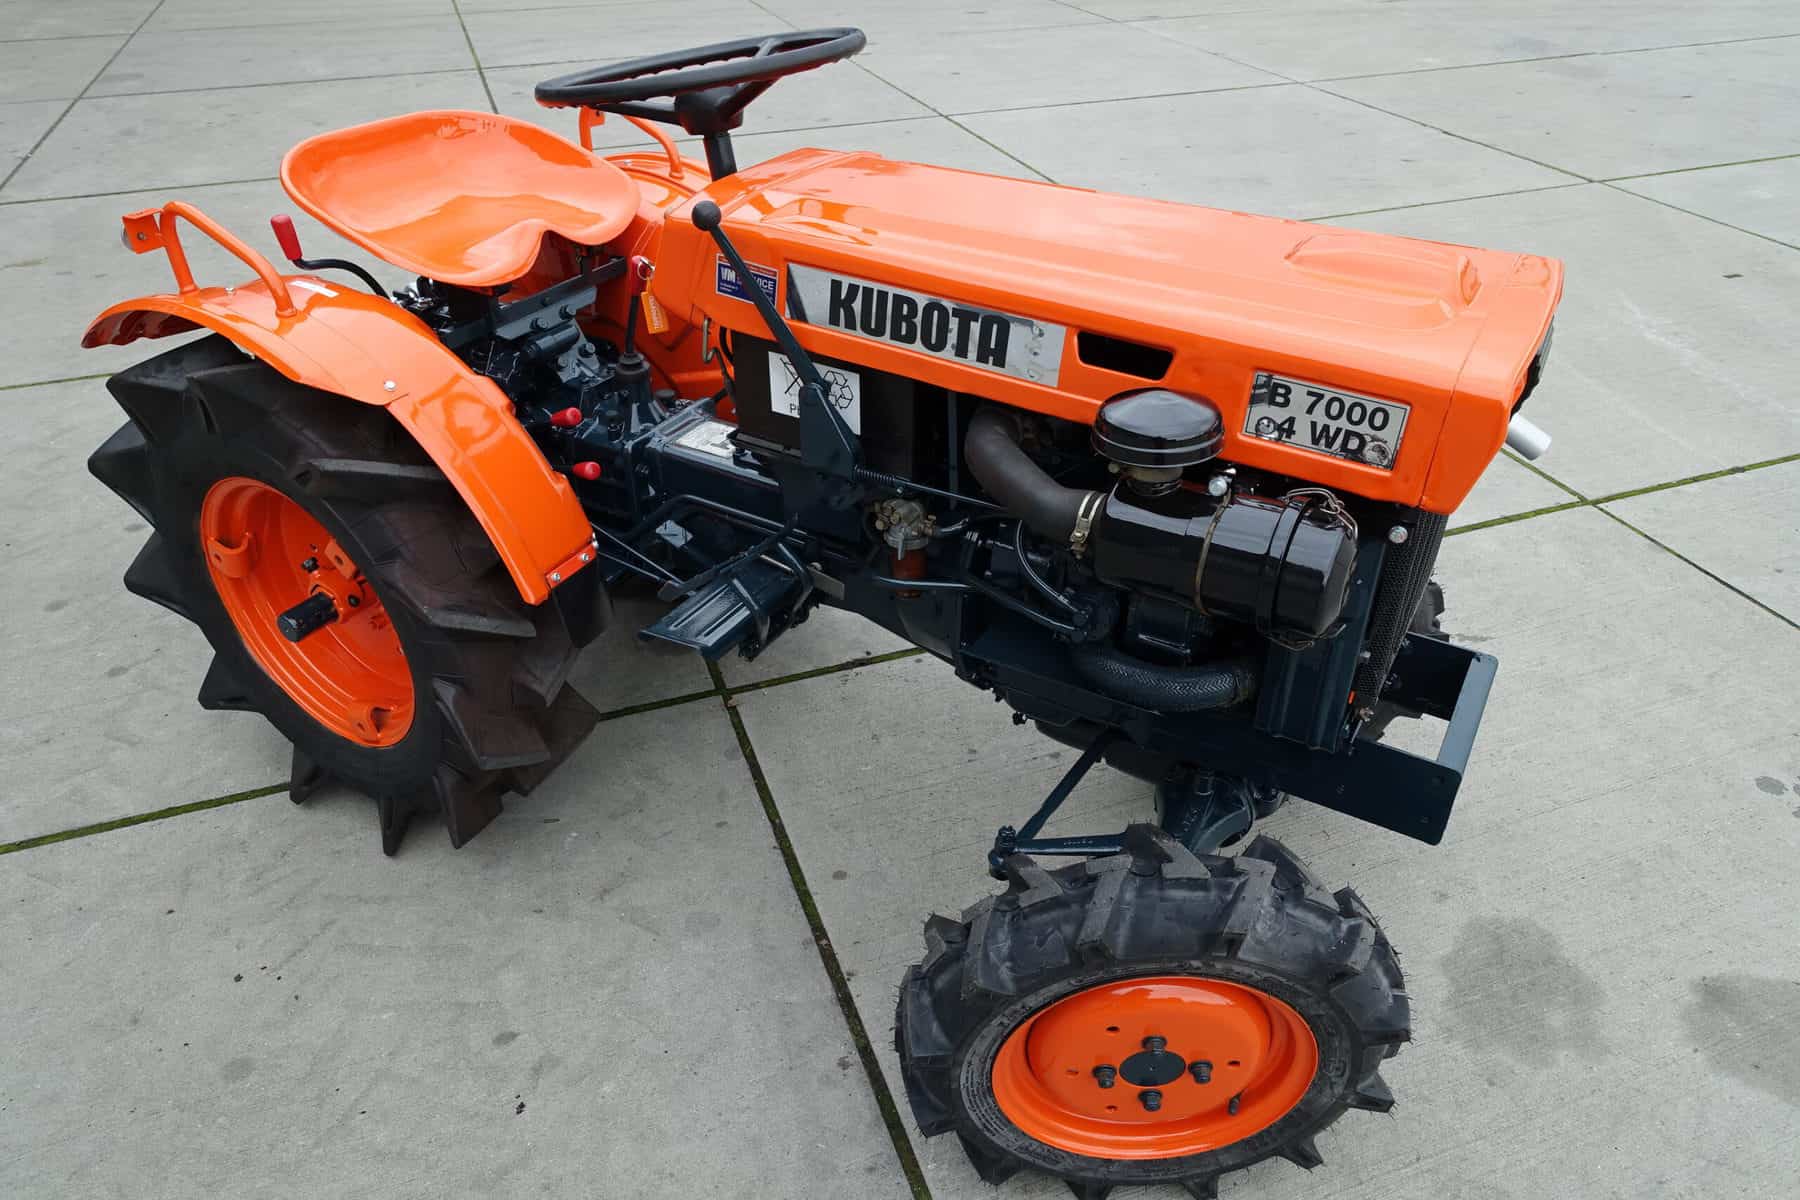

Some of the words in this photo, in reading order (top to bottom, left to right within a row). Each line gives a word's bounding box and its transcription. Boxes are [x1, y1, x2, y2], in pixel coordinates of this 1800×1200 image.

[829, 279, 1010, 368] KUBOTA
[1269, 382, 1292, 408] B
[1305, 391, 1390, 432] 7000
[1278, 416, 1296, 439] 4
[1310, 421, 1367, 455] WD
